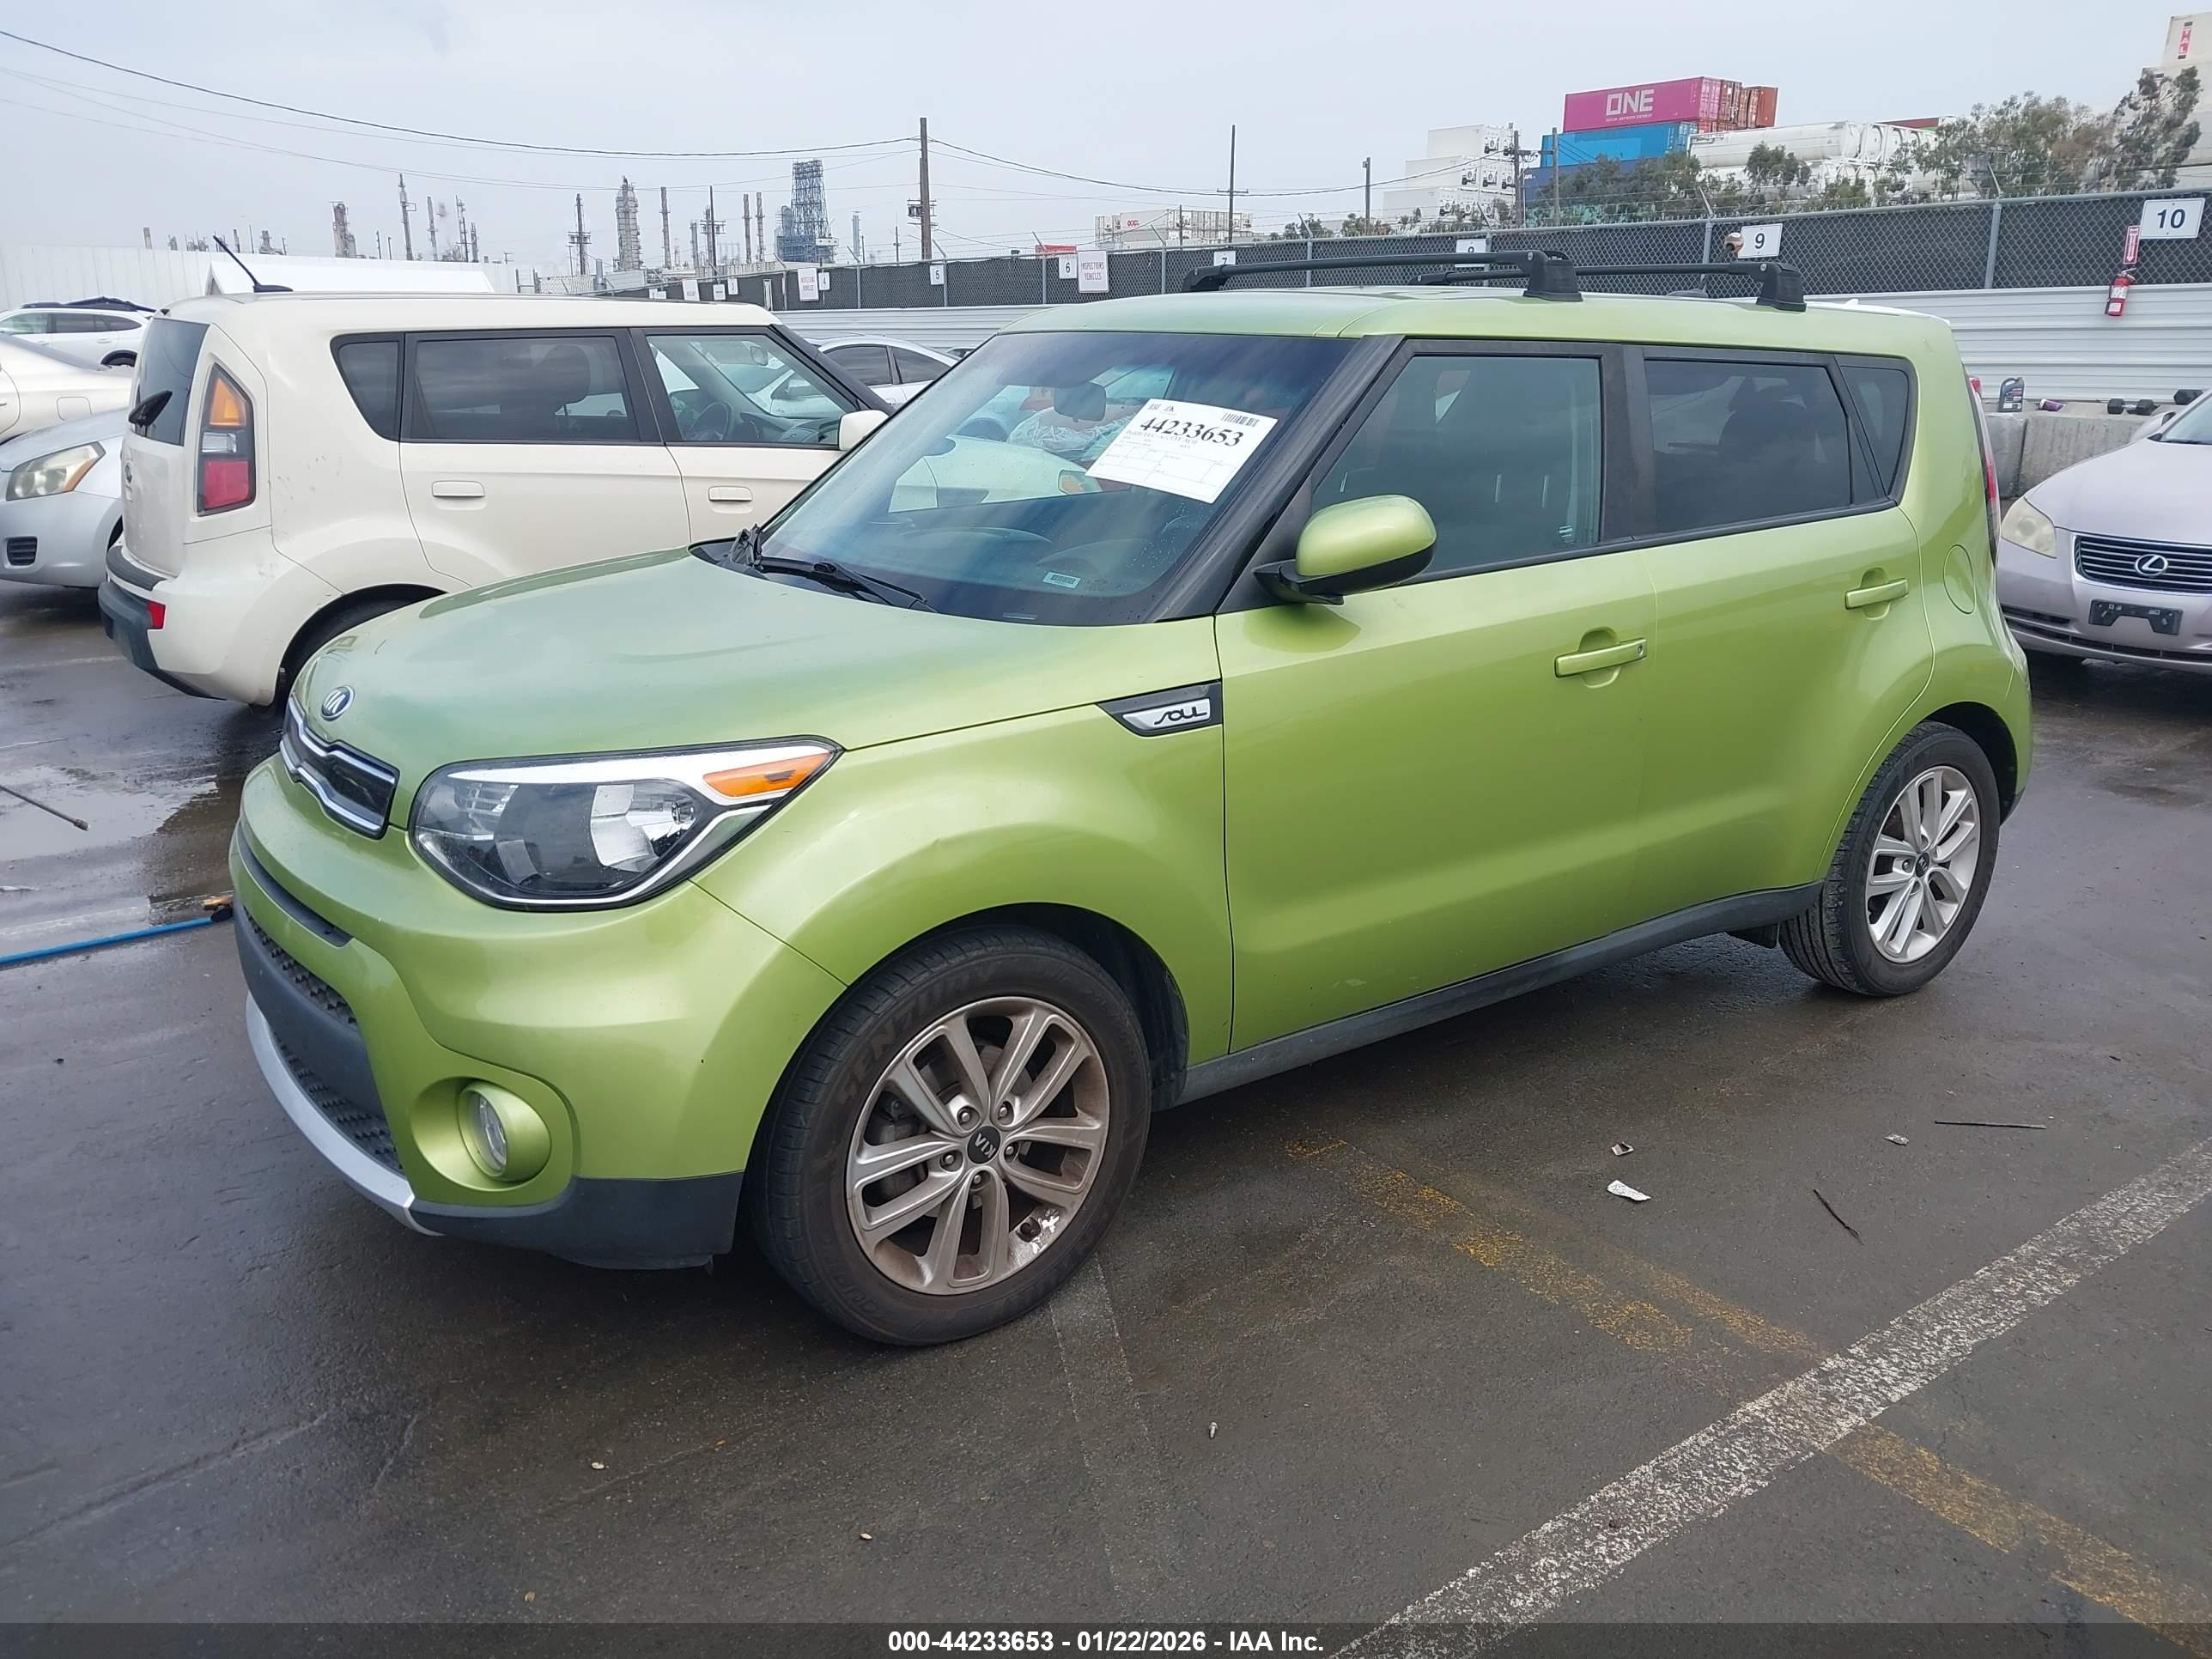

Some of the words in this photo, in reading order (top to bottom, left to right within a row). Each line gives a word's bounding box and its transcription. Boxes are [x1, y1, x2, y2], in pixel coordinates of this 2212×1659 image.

[1606, 89, 1655, 116] ONE
[2157, 209, 2186, 229] 10
[1754, 233, 1765, 249] 9
[935, 270, 940, 280] 5
[1065, 262, 1071, 273] 6
[1139, 417, 1244, 447] 44233653
[975, 1133, 997, 1159] KIA
